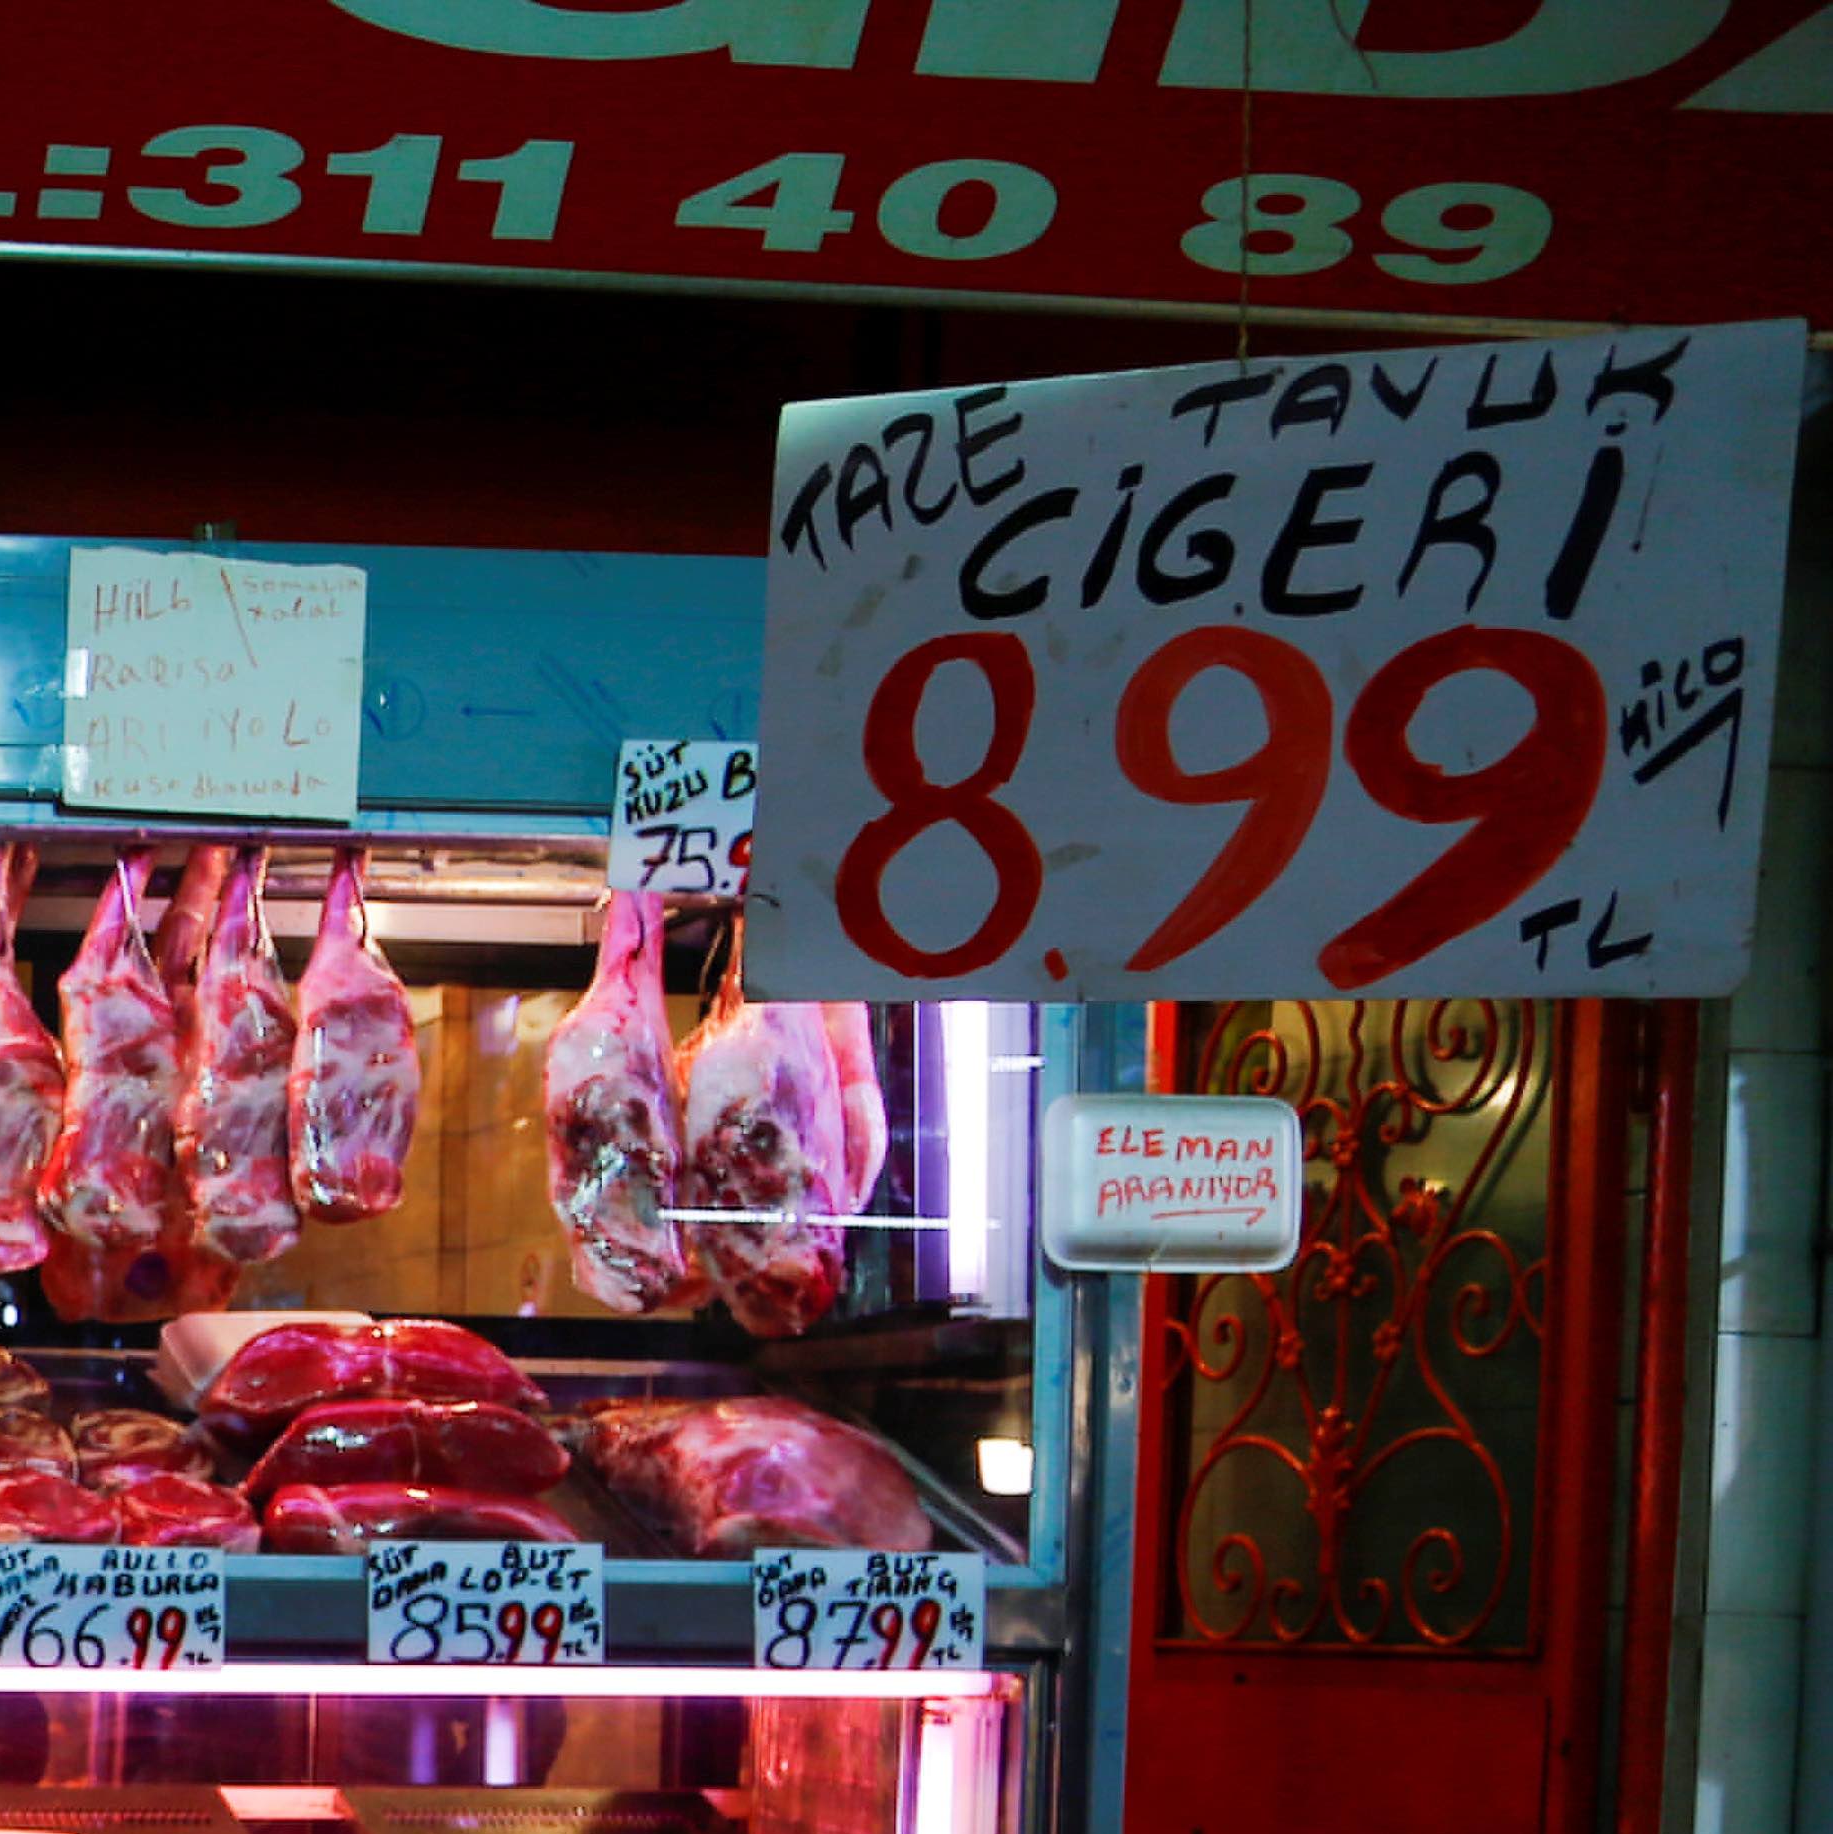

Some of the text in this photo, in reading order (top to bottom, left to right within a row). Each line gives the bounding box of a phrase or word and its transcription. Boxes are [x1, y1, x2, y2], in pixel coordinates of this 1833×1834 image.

[675, 152, 1059, 260] 40
[1180, 173, 1554, 285] 89
[781, 334, 1691, 573] TAZE TAVUK
[835, 623, 1608, 991] 8.99
